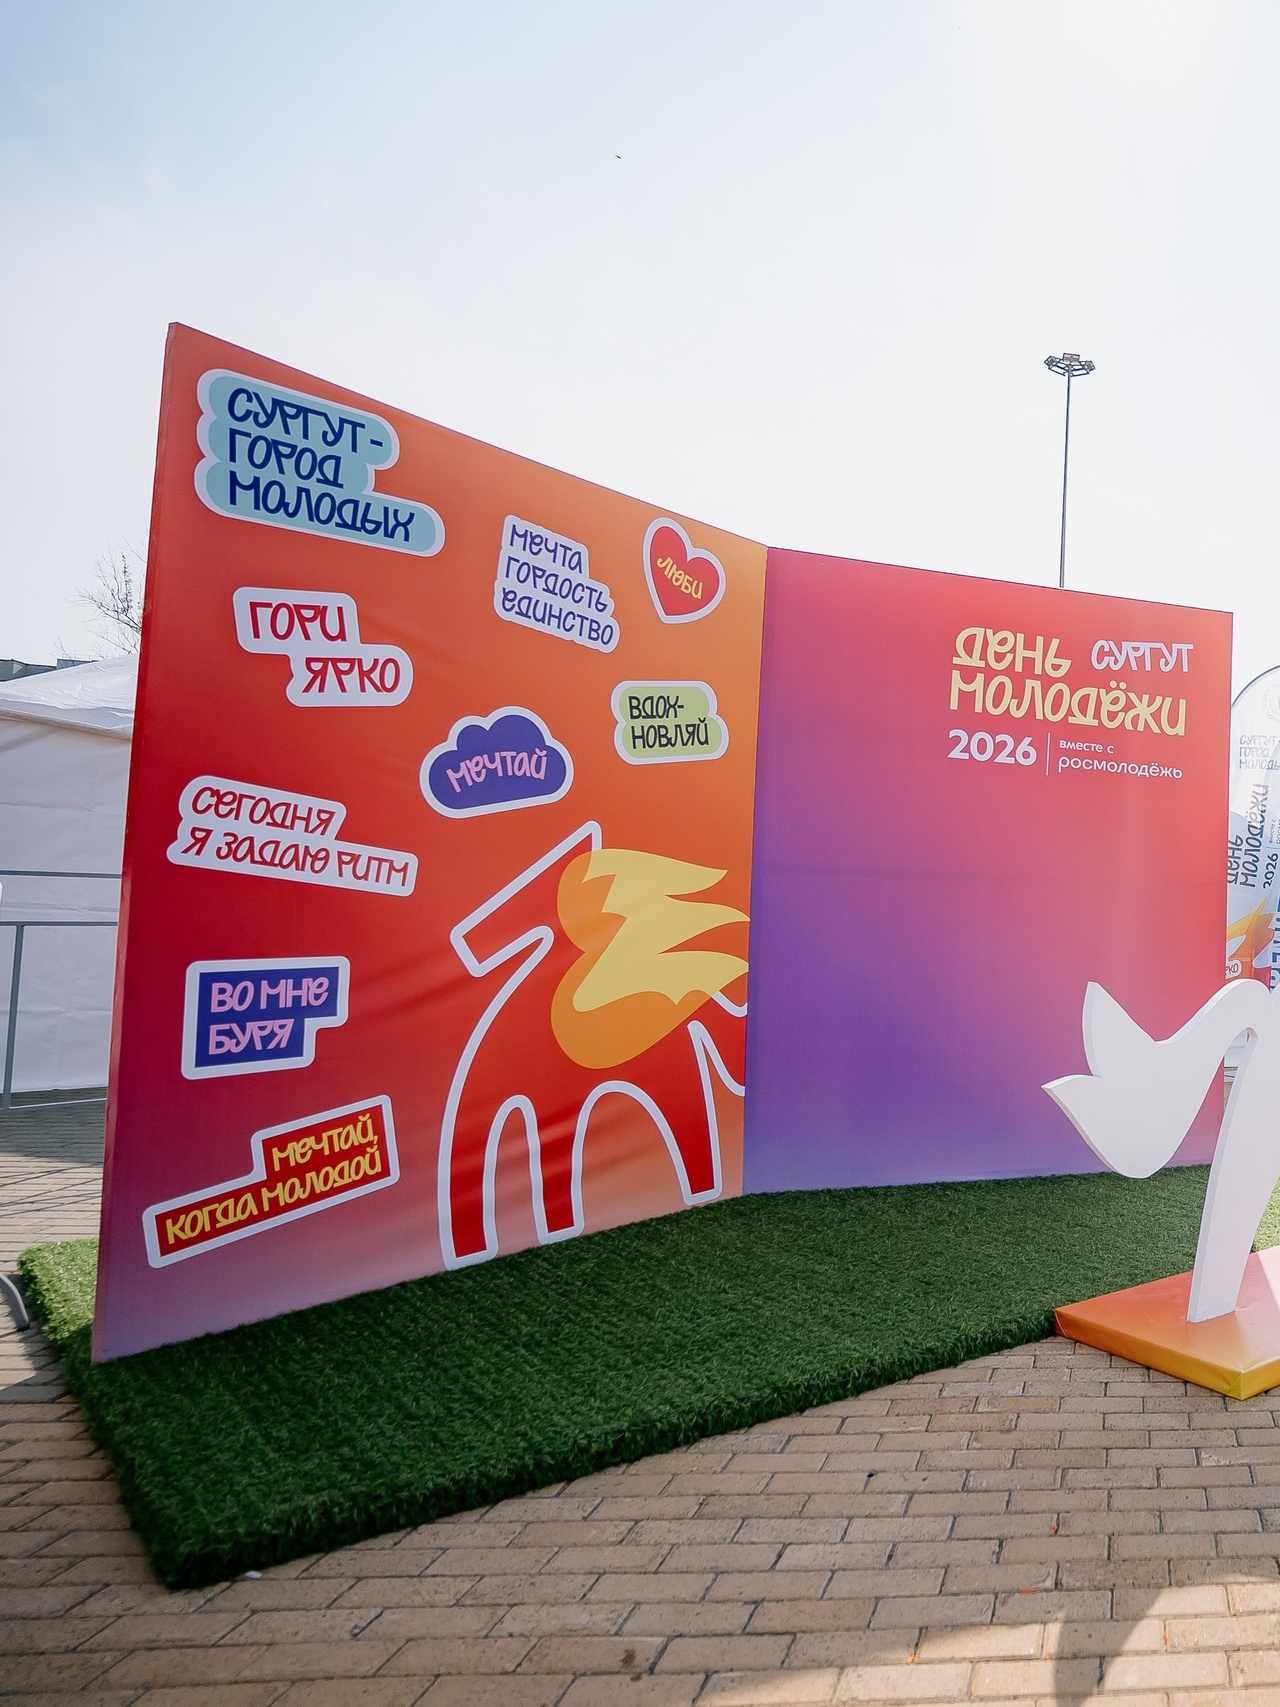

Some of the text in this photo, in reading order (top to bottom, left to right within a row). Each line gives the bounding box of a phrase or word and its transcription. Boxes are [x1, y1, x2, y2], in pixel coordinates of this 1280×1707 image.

[229, 428, 344, 488] ГОРОД
[229, 471, 415, 543] МОЛОДЫХ
[505, 555, 609, 614] ГОРДОСТЬ
[657, 555, 703, 600] ЛЮБИ
[249, 600, 347, 641] ГОРИ
[501, 586, 614, 646] ЕДИНСТВО
[952, 626, 1193, 678] ДЕНЬ СУРГУТ
[301, 657, 400, 694] ЯРКО
[628, 695, 685, 721] ВДОХ-
[950, 670, 1186, 736] МОЛОДЁЖИ
[631, 718, 709, 749] НОВЛЯЙ
[947, 729, 1037, 766] 2026
[1059, 739, 1114, 754] вместе с
[1240, 747, 1269, 757] ГОРОД
[445, 748, 548, 793] МЕЧТАЙ
[1058, 756, 1182, 779] росмолодёжь
[191, 785, 336, 837] СЕГОДНЯ
[182, 826, 409, 887] Я ЗАДАЮ РИТМ
[1263, 853, 1278, 889] 2026
[210, 977, 329, 1013] ВО МНЕ
[208, 1019, 294, 1054] БУРЯ
[165, 1147, 382, 1245] КОГДА МОЛОДОЙ
